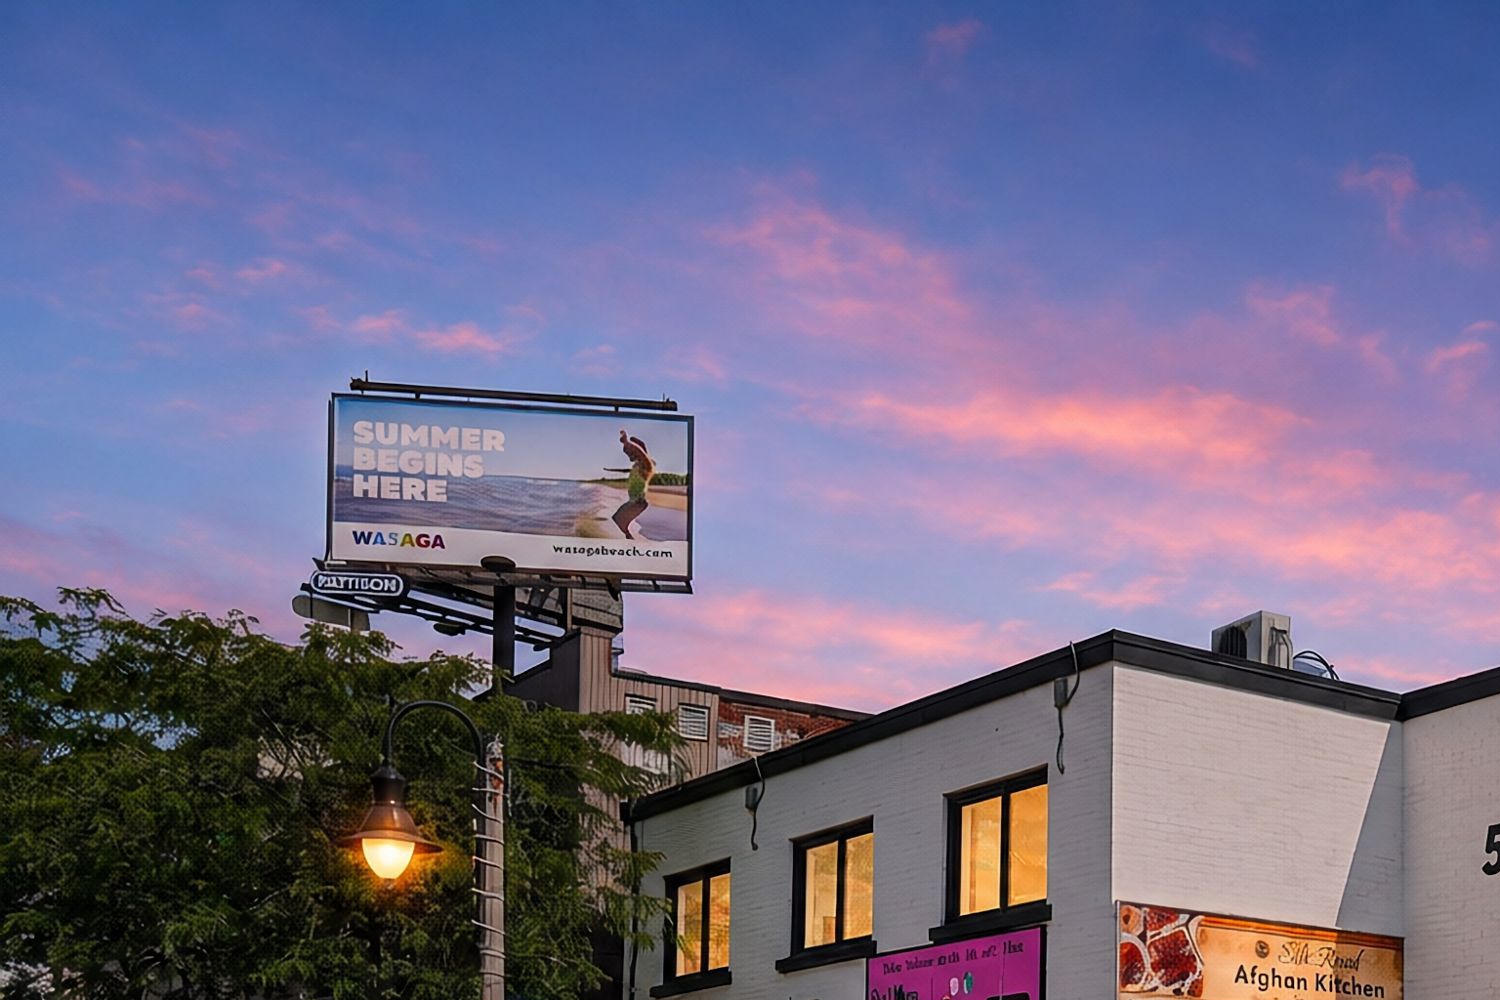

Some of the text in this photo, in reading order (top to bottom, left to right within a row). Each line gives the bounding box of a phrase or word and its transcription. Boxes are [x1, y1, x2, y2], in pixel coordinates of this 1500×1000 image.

[353, 420, 505, 452] SUMMER
[353, 447, 485, 479] BEGINS
[353, 474, 448, 502] HERE
[352, 530, 446, 550] WASAGA
[1234, 964, 1385, 999] Afghan Kitchen
